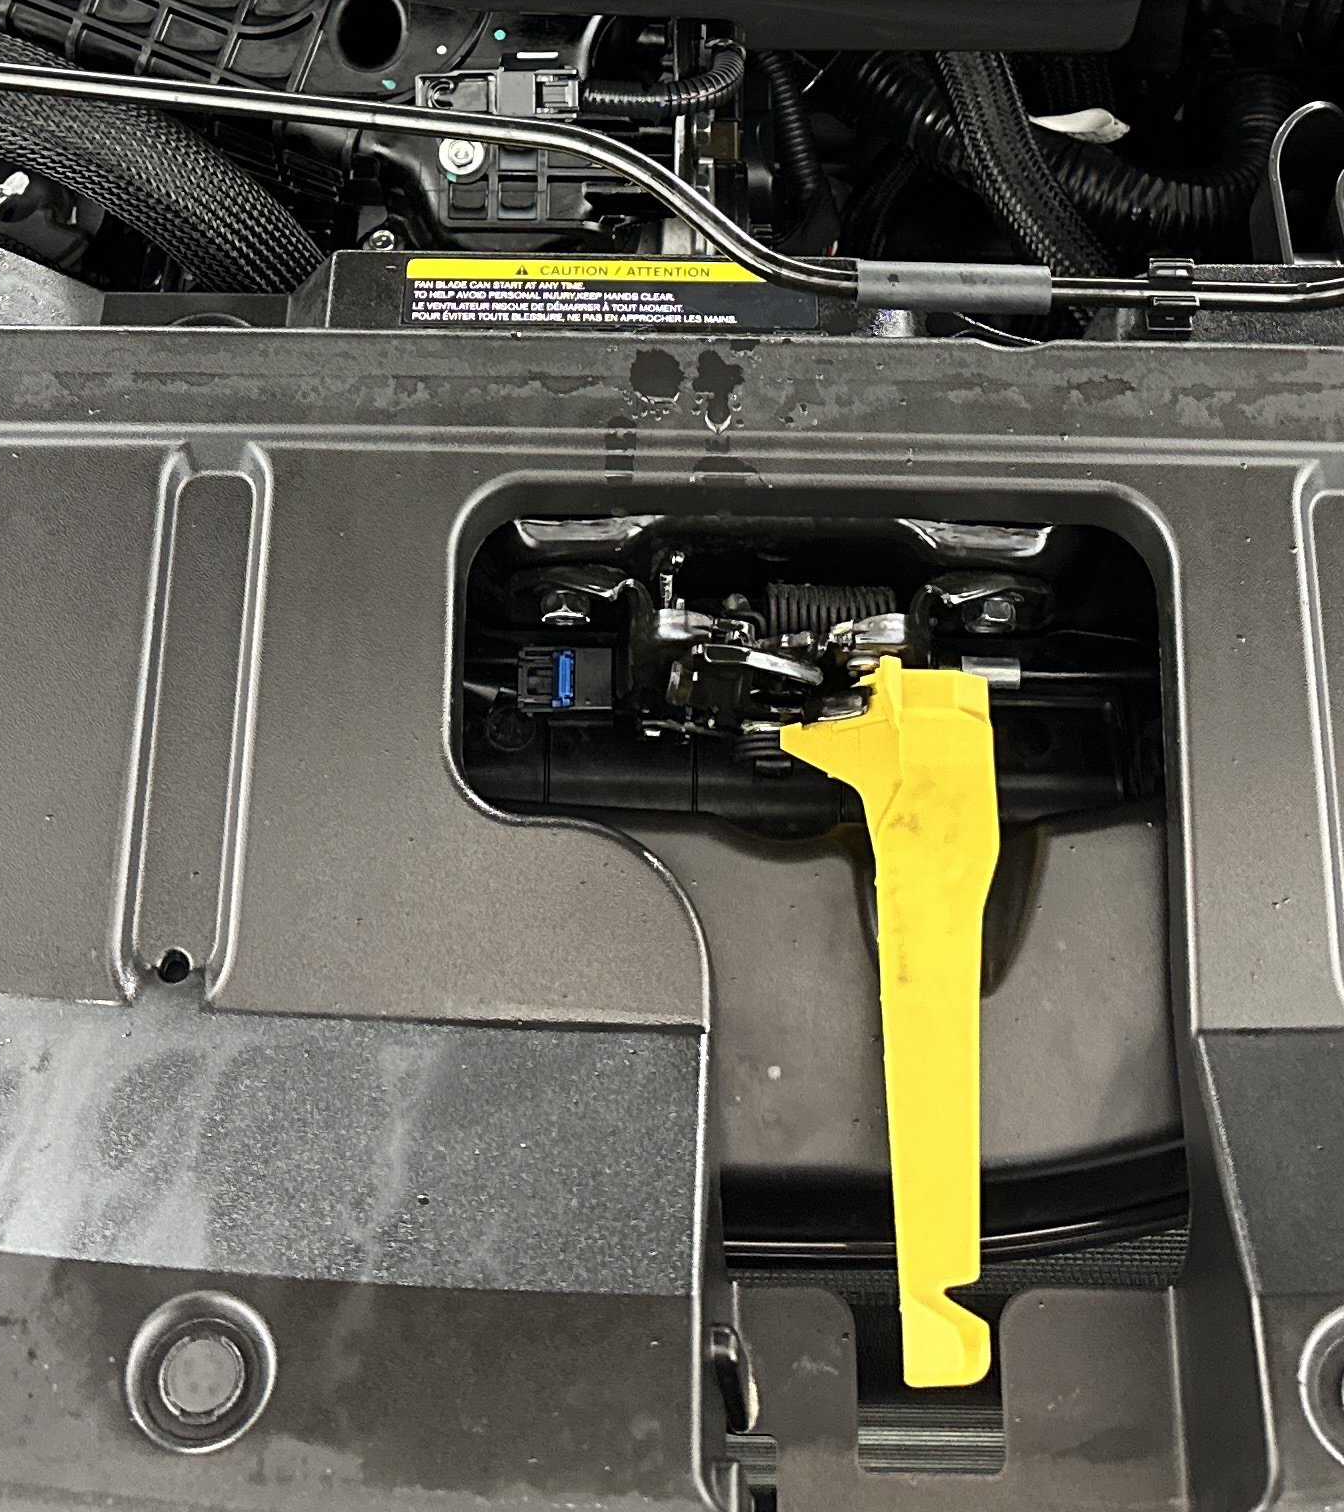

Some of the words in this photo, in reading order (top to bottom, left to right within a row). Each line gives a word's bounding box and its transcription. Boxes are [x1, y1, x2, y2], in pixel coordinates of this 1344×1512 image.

[539, 264, 608, 277] CAUTION
[626, 265, 711, 278] ATTENTION
[414, 280, 435, 289] FAN
[435, 280, 468, 289] BLADE
[469, 281, 491, 289] CAN
[493, 281, 524, 290] START
[524, 282, 538, 290] AT
[539, 282, 559, 290] ANY
[414, 290, 428, 298] TO
[429, 290, 456, 299] HELP
[456, 291, 487, 299] AVOID
[488, 291, 542, 300] PERSONAL
[604, 292, 639, 301] HANDS
[412, 301, 425, 309] LE
[427, 301, 490, 310] VENTILATEUR
[492, 302, 529, 311] RISQUE
[531, 303, 545, 311] DE
[611, 304, 638, 312] TOUT
[412, 312, 441, 320] POUR
[442, 310, 476, 321] ÉVITER
[477, 312, 510, 321] TOUTE
[567, 314, 581, 322] NE
[582, 314, 603, 322] PAS
[604, 314, 618, 322] EN
[619, 314, 683, 323] APPROCHER
[684, 315, 702, 323] LES
